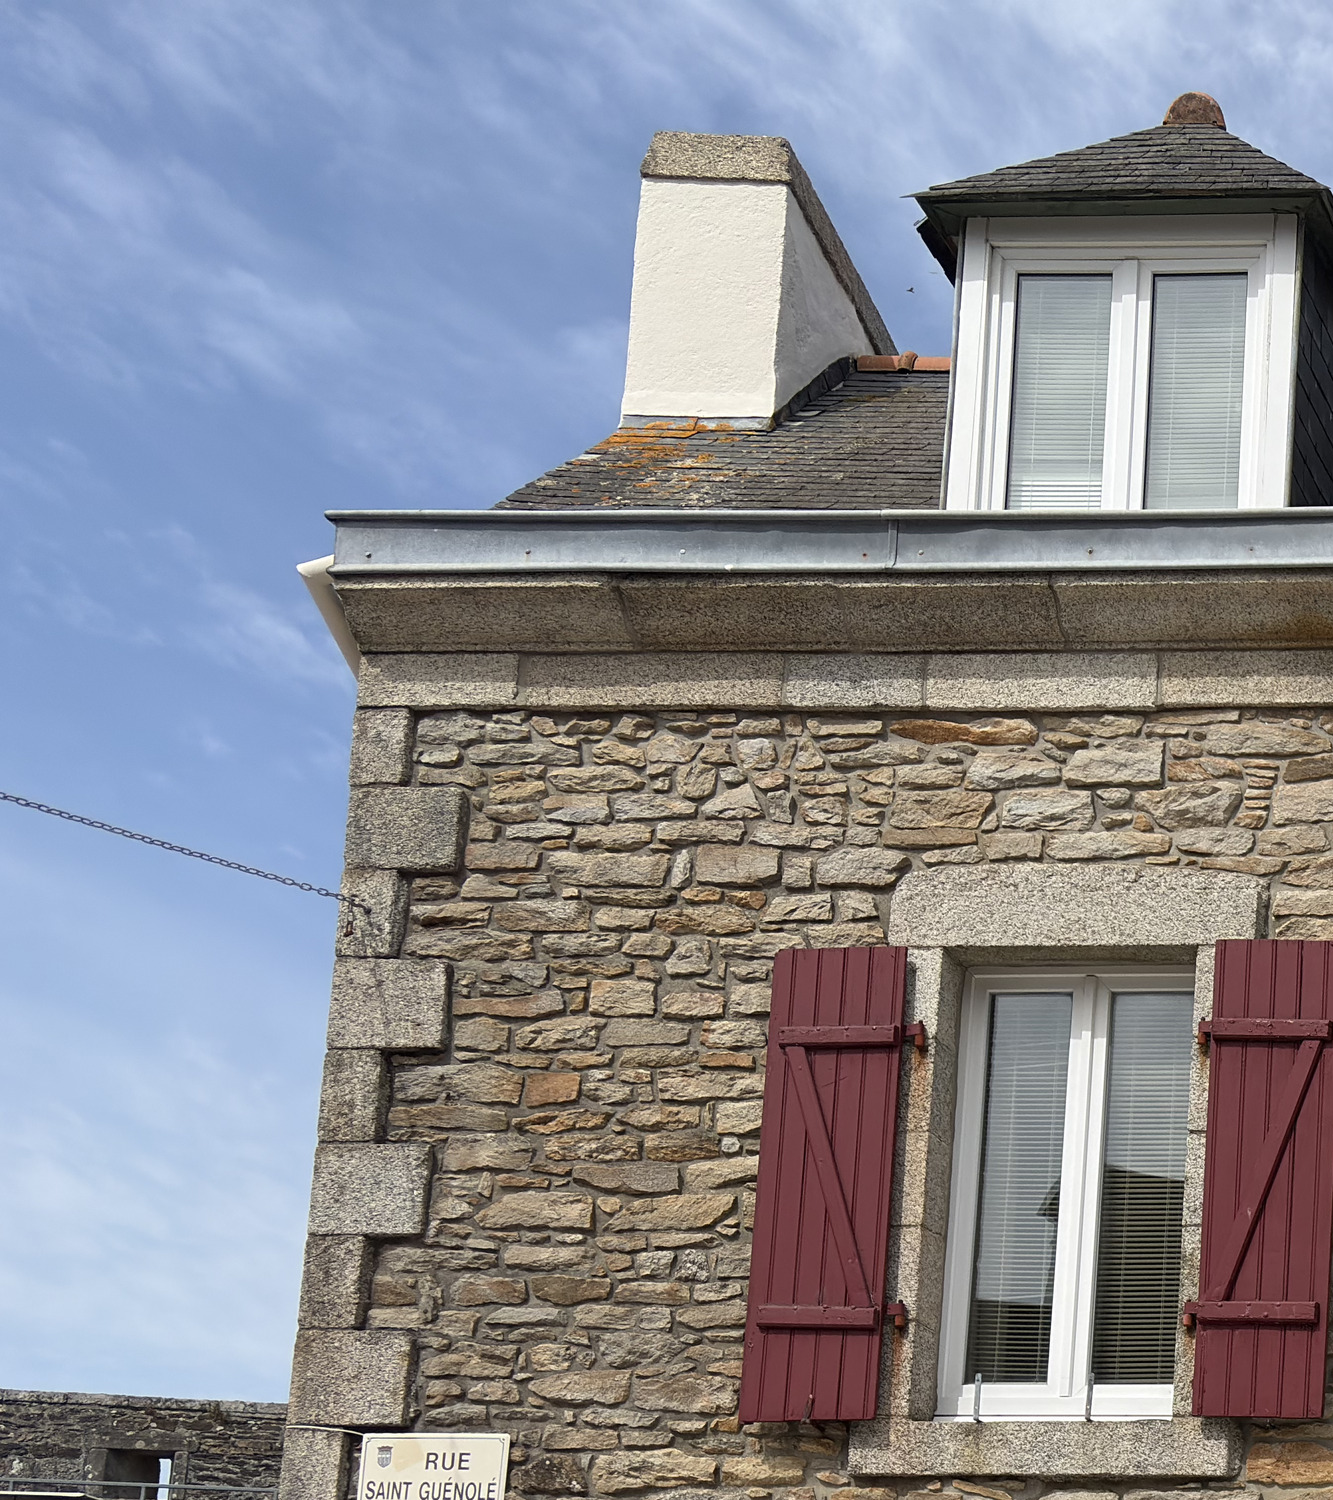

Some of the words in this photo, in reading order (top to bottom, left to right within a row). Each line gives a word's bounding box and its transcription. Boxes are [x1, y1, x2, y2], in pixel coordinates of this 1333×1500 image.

[425, 1453, 471, 1470] RUE
[365, 1481, 413, 1500] SAINT
[419, 1477, 497, 1500] GUÉNOLÉ
